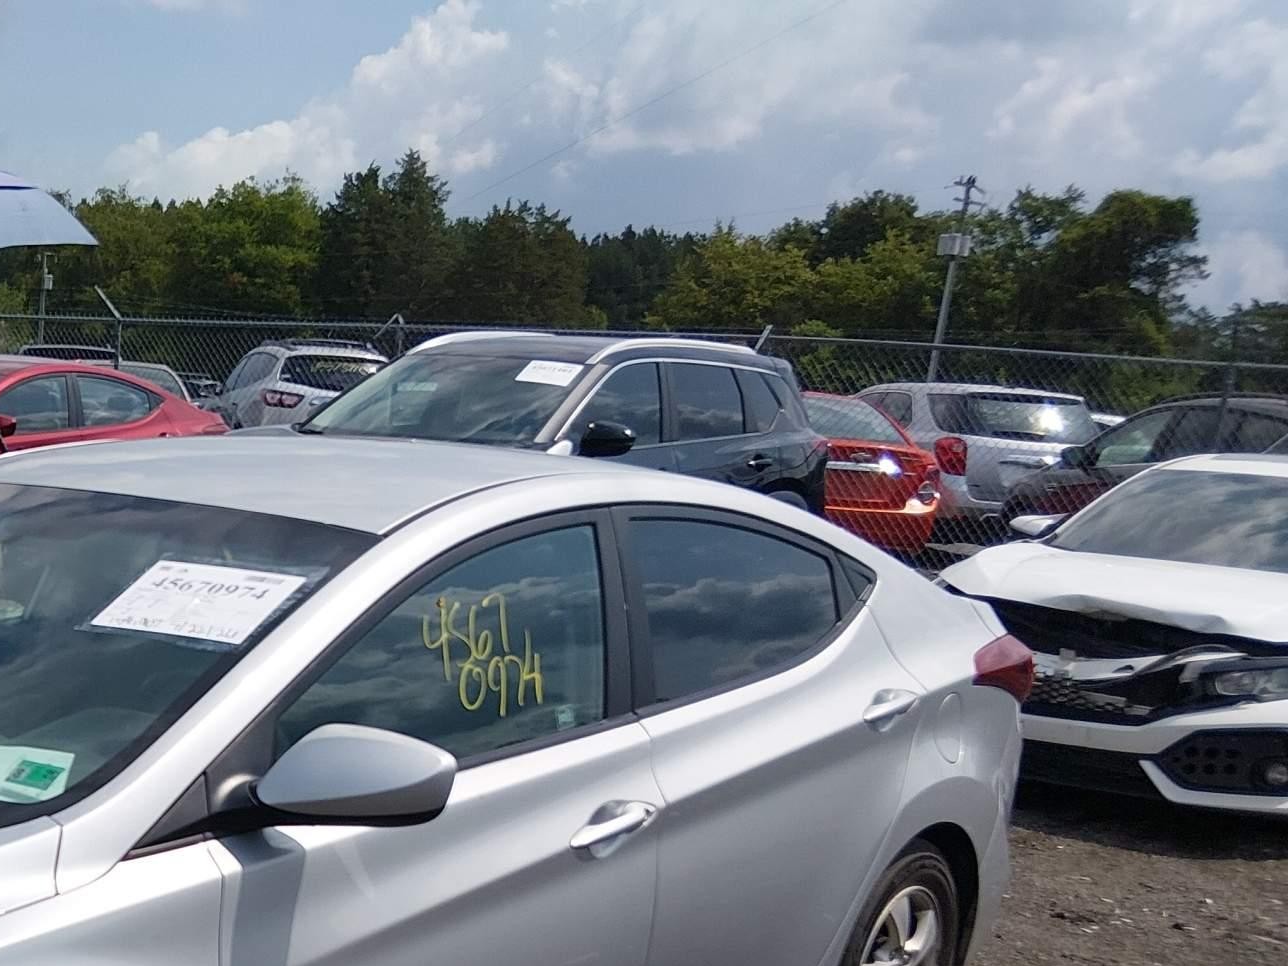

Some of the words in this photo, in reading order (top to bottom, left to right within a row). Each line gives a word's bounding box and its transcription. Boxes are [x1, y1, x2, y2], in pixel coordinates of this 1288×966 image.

[151, 576, 271, 601] 45670974
[422, 592, 510, 681] 4567
[459, 629, 544, 718] 0974
